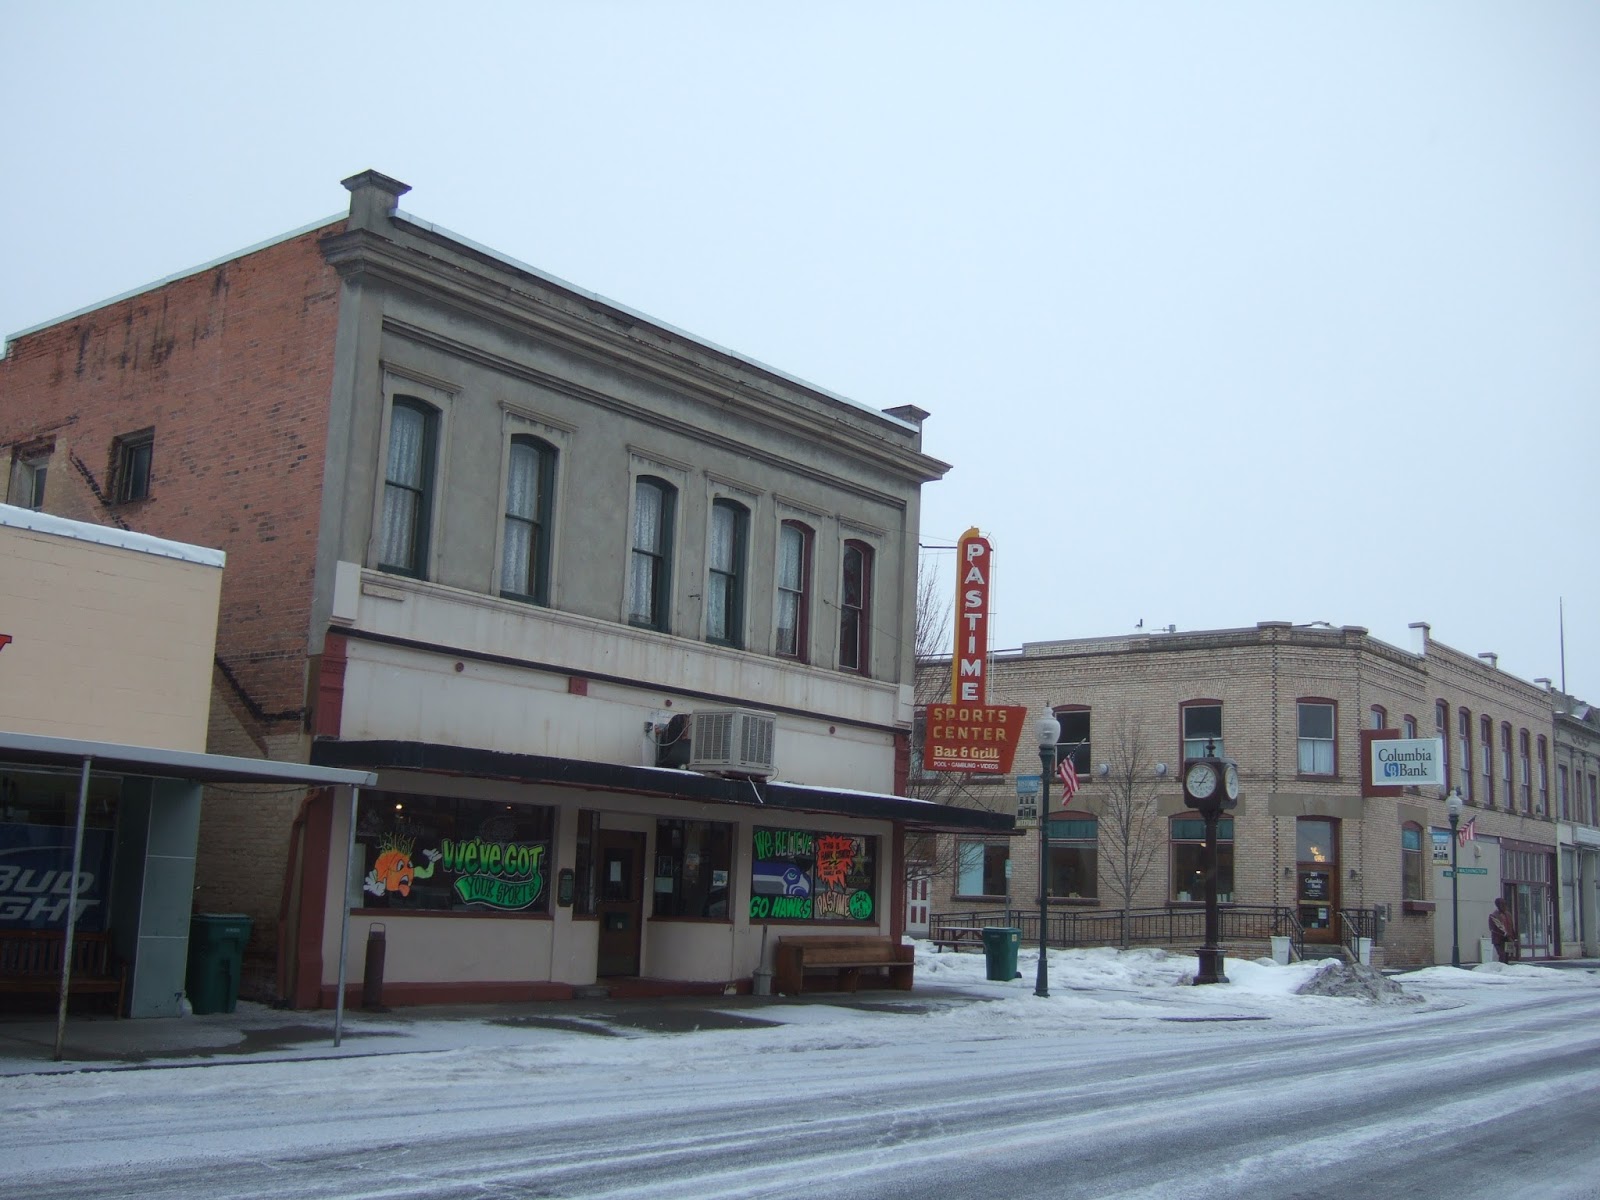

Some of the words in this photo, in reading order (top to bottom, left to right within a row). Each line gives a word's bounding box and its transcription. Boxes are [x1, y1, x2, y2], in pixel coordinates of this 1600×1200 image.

[960, 543, 985, 700] PASTIME
[933, 707, 1007, 723] SPORTS
[933, 725, 1007, 741] CENTER
[934, 745, 957, 757] Bar
[960, 746, 968, 758] &
[970, 746, 1000, 759] Grill
[1378, 748, 1432, 762] Columbia
[1400, 763, 1427, 776] Bank
[775, 831, 813, 856] BELIEVE
[504, 843, 544, 876] GOT
[0, 865, 95, 894] BUD
[466, 878, 496, 899] YOUR
[497, 883, 536, 905] SPORTS
[0, 896, 101, 922] GHT
[749, 896, 770, 918] GO
[771, 896, 813, 919] HAWKS
[817, 891, 850, 916] PASTIME
